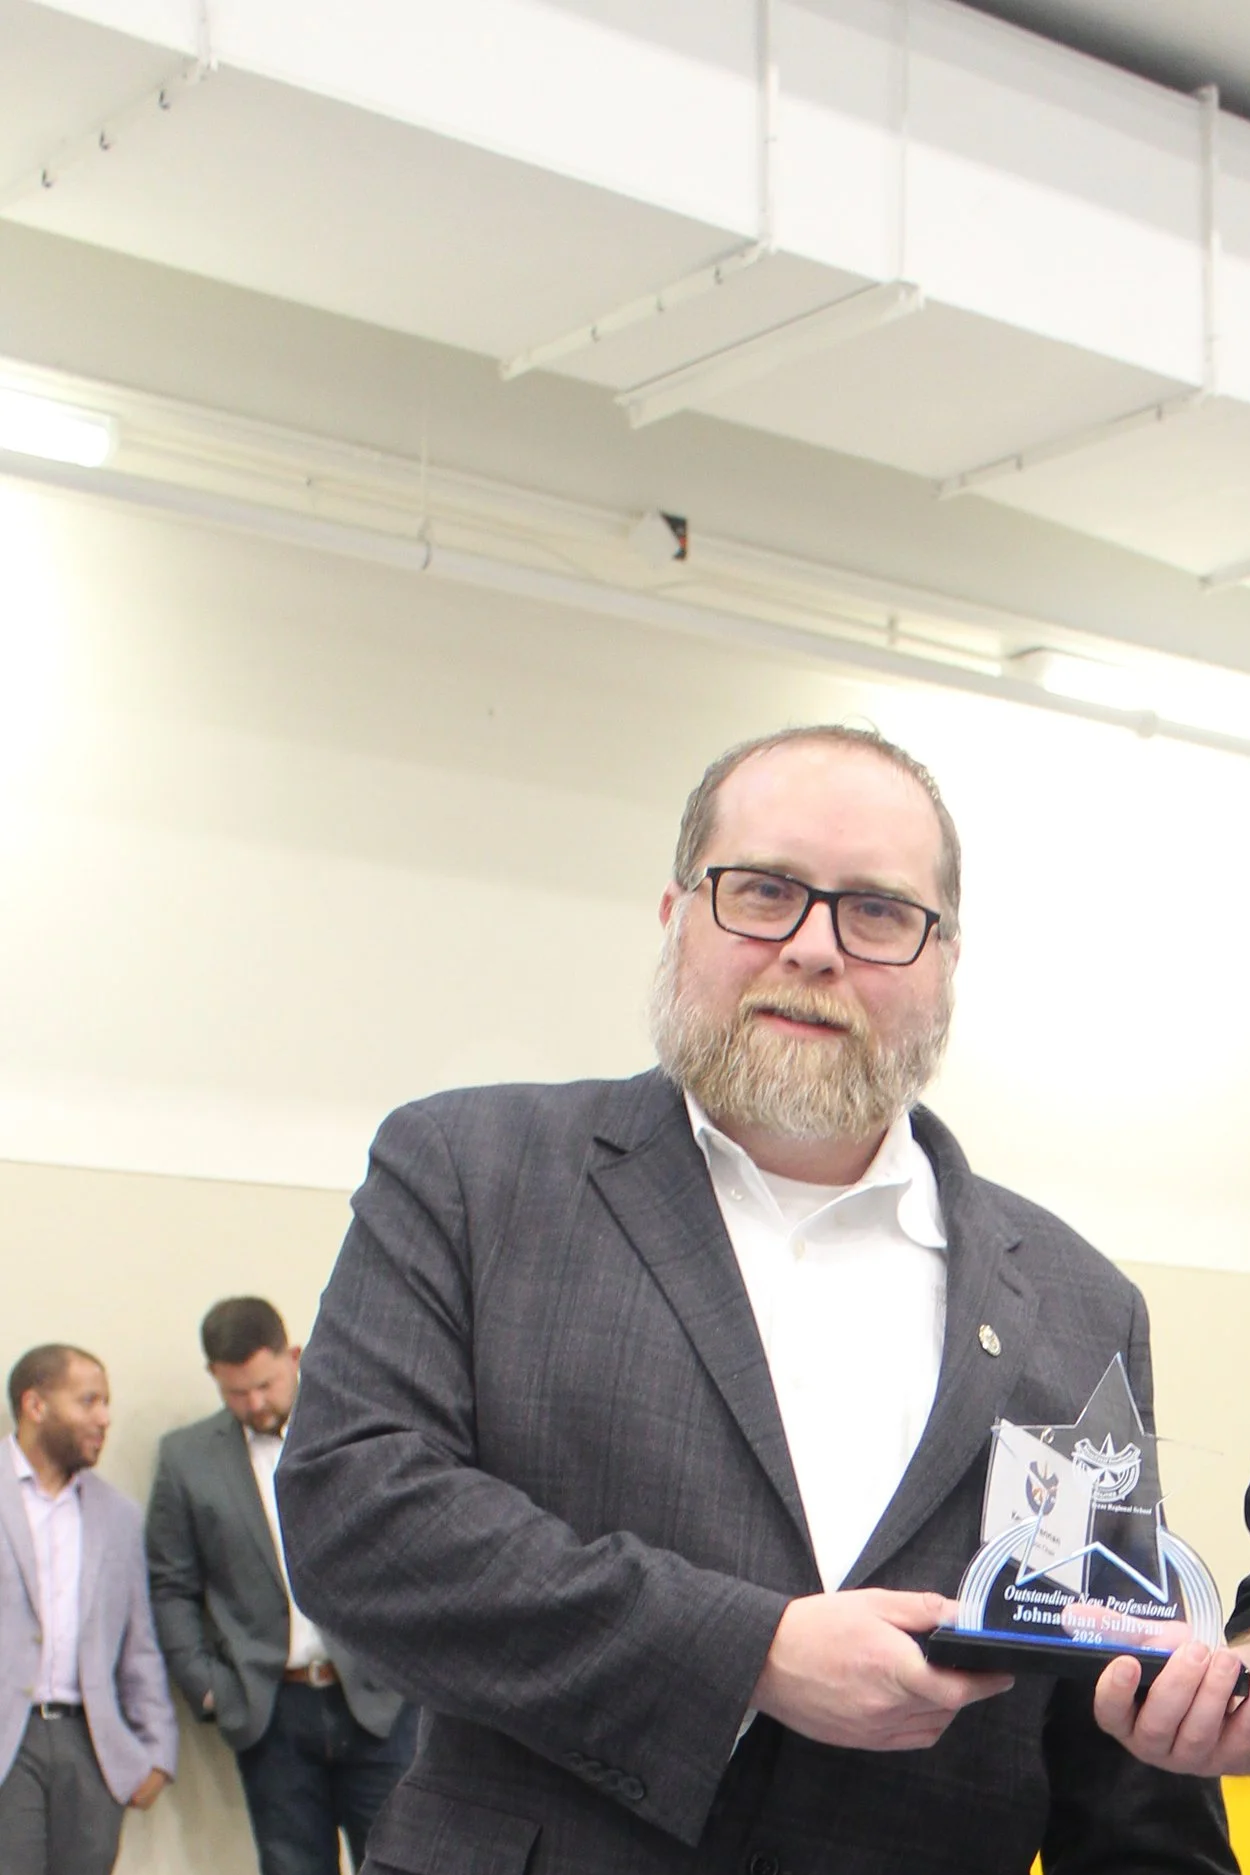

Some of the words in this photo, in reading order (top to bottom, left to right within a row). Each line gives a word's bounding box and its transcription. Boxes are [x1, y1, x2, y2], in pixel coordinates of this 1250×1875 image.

[1003, 1584, 1075, 1607] Outstanding
[1077, 1592, 1104, 1608] New
[1105, 1595, 1178, 1619] Professional
[1012, 1604, 1096, 1628] Johnathan
